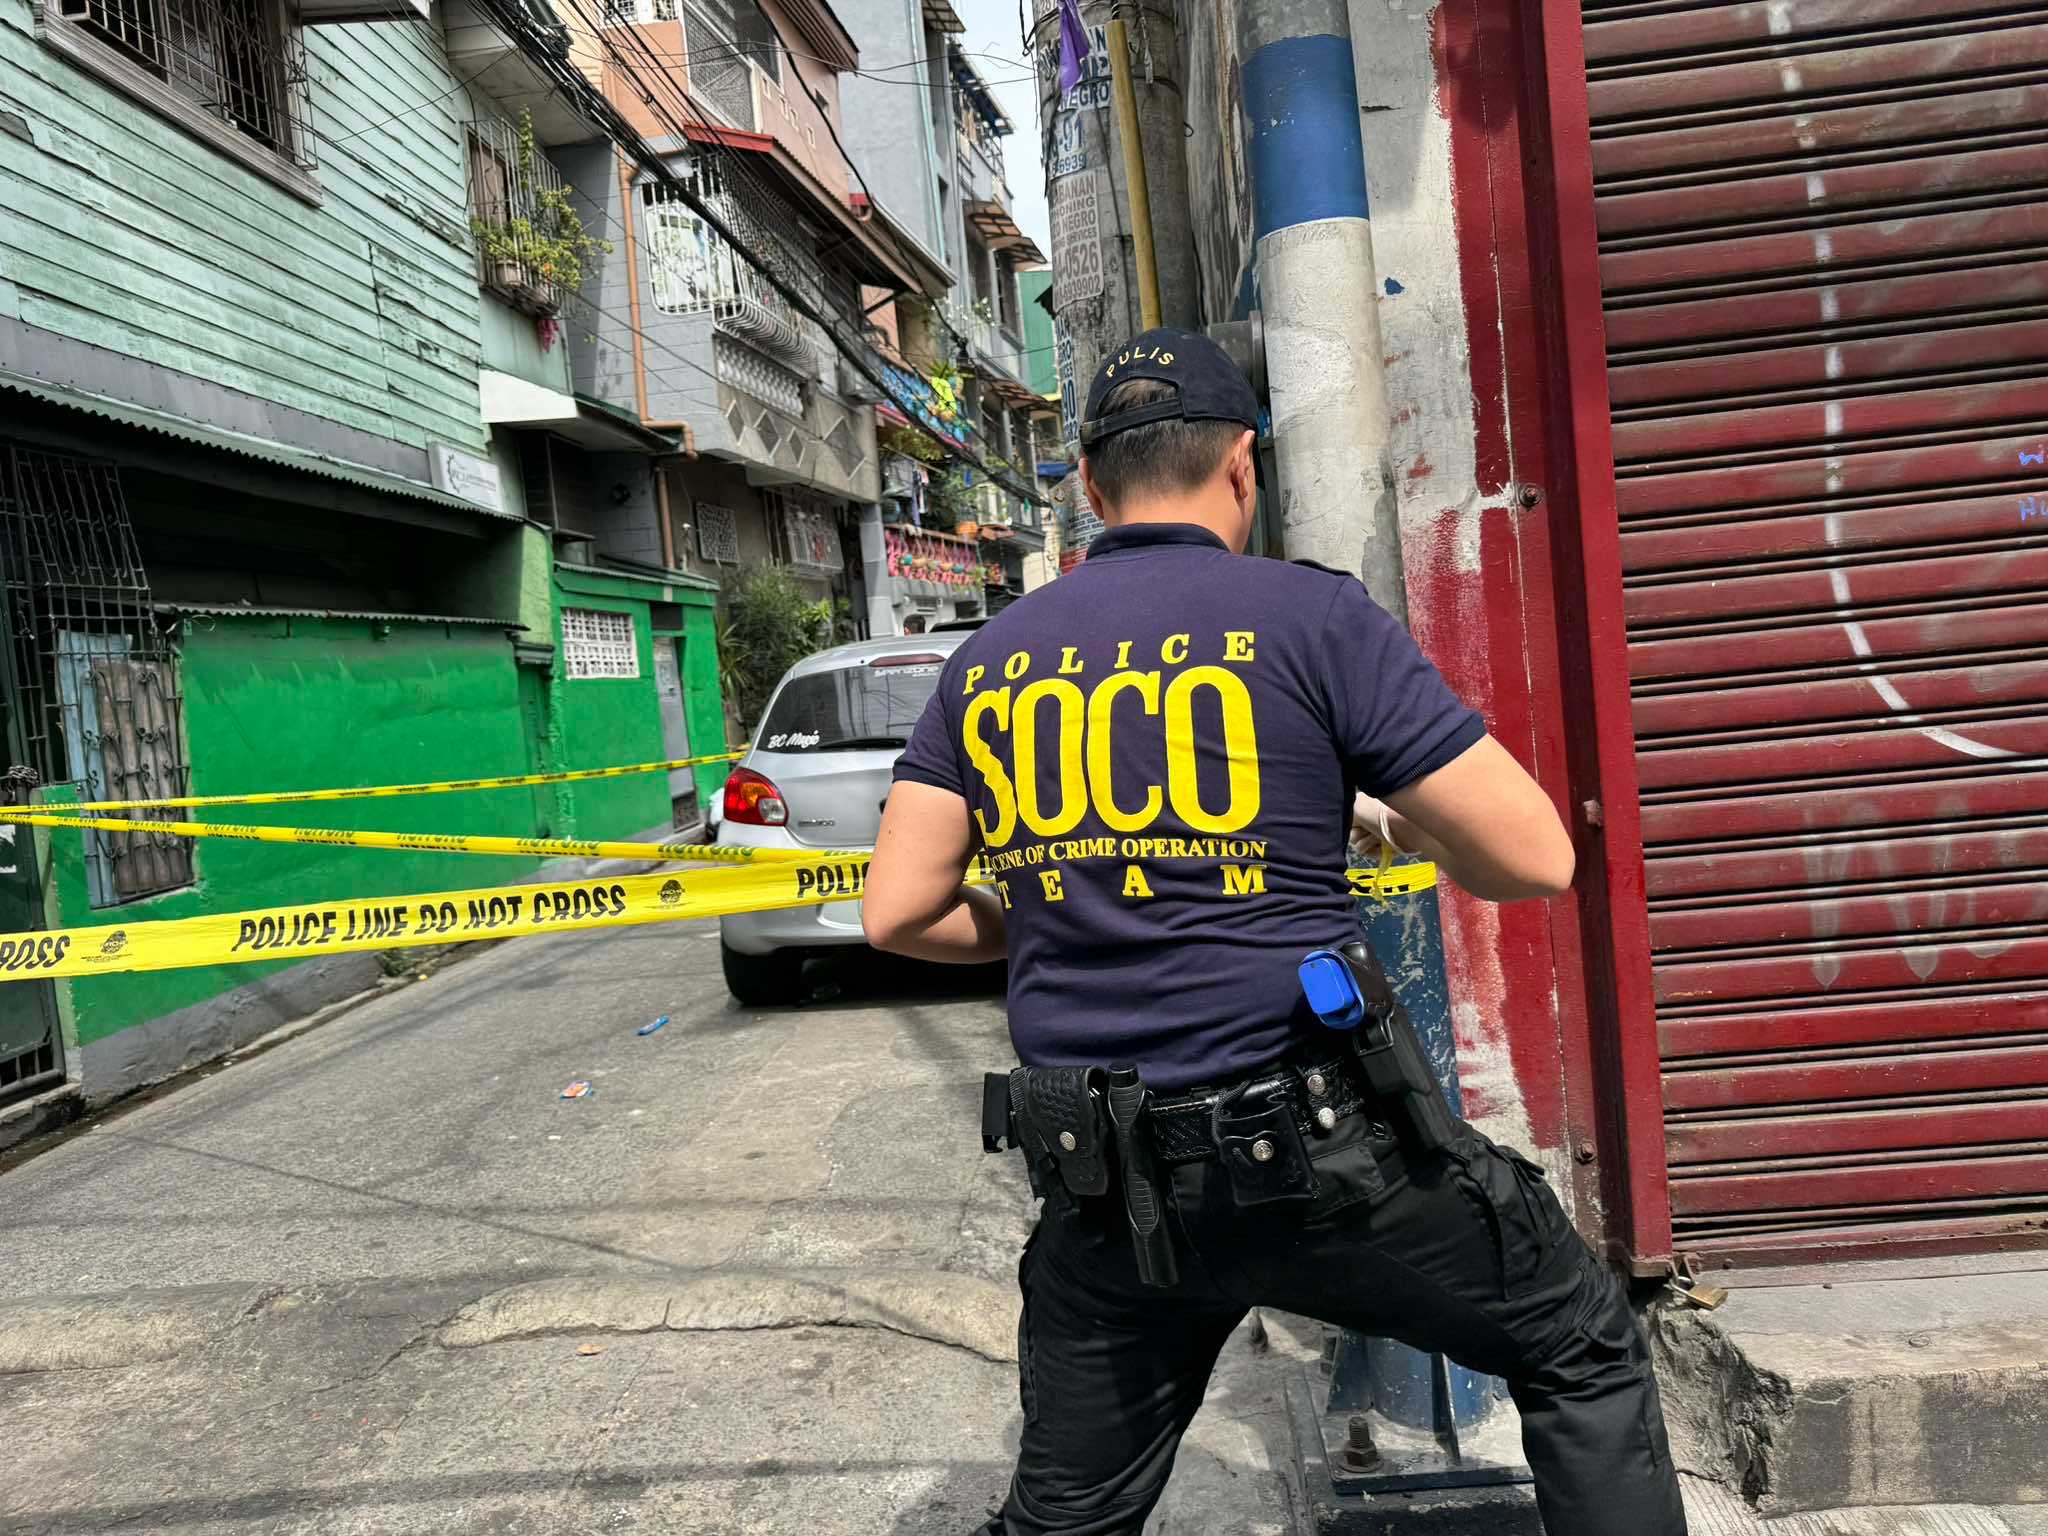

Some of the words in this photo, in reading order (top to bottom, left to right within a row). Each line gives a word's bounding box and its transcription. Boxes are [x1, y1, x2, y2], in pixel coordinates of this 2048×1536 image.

[1106, 346, 1175, 378] PULIS
[962, 631, 1256, 696] POLICE
[962, 665, 1261, 847] SOCO
[1025, 843, 1045, 865] OF
[1048, 837, 1117, 861] CRIME
[1121, 837, 1268, 859] OPERATION
[998, 864, 1268, 910] TEAM
[231, 911, 337, 952] POLICE
[341, 905, 408, 941] LINE
[414, 899, 458, 935] DO
[463, 895, 523, 930] NOT
[531, 884, 626, 923] CROSS
